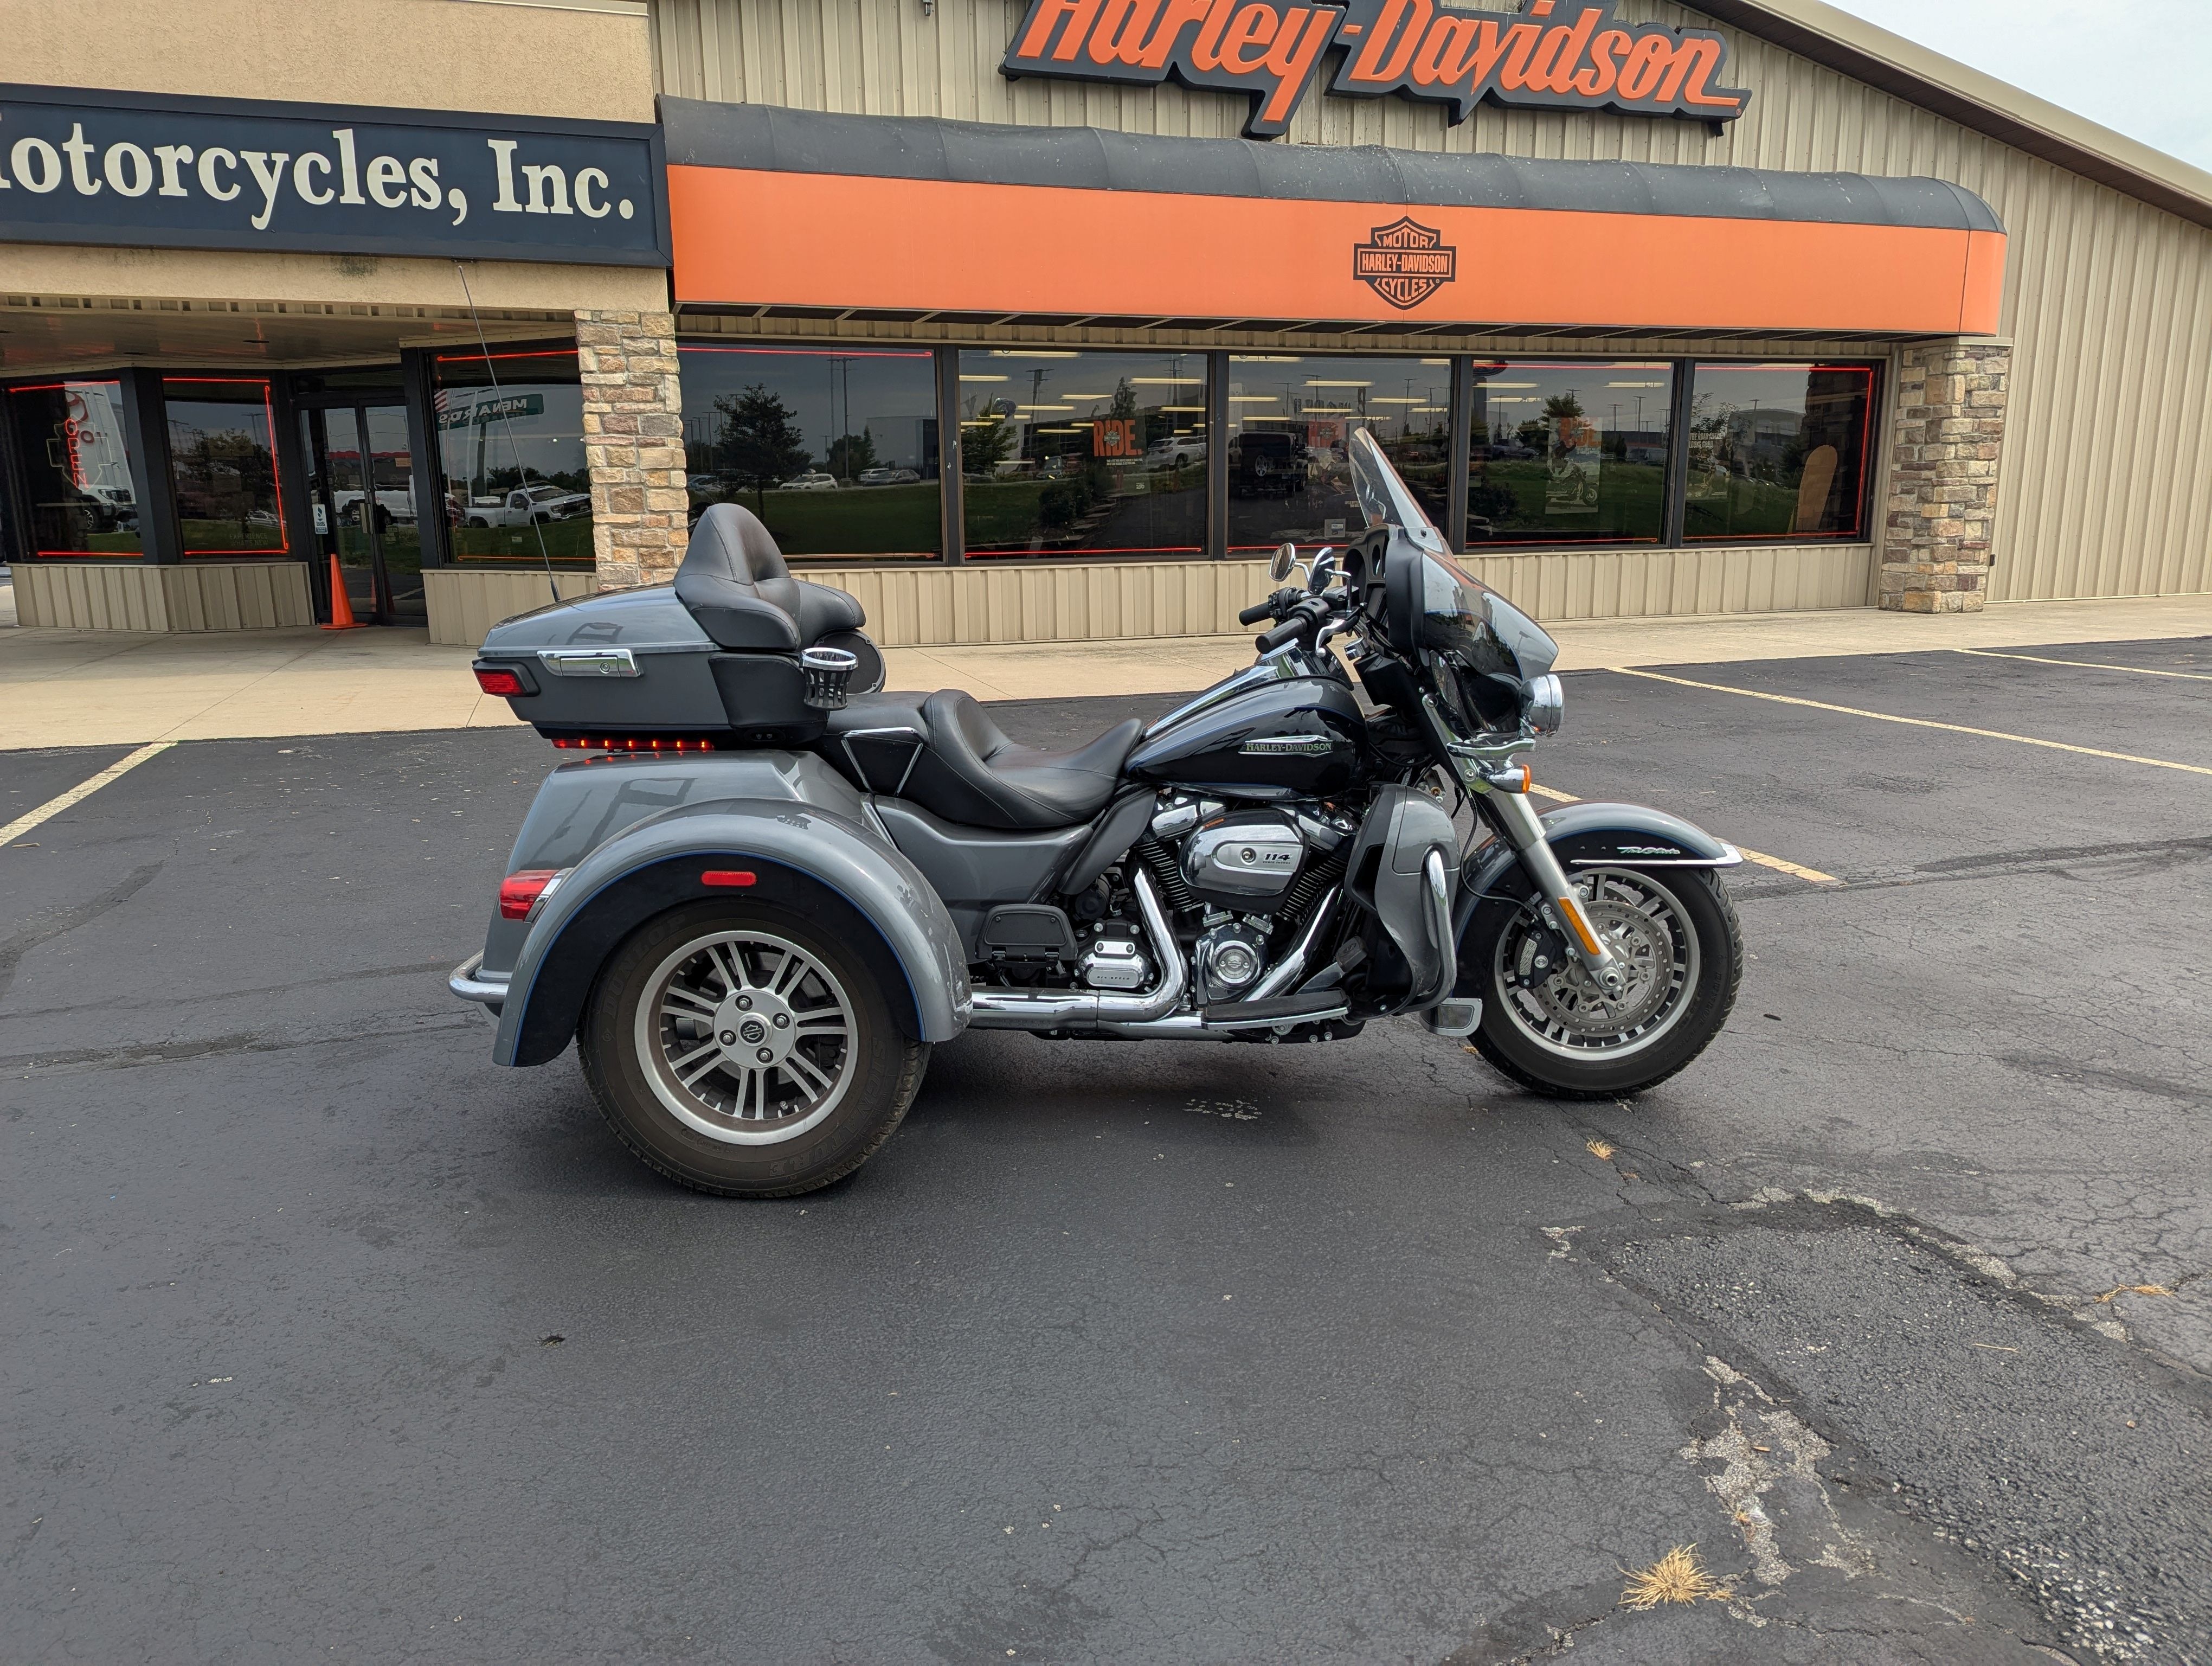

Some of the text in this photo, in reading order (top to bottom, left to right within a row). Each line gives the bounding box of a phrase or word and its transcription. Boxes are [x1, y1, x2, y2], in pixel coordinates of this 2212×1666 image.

[1017, 0, 1741, 123] Harley-Davidson
[0, 113, 634, 229] otorcycles, Inc.
[1383, 227, 1429, 248] MOTOR
[1362, 253, 1448, 273] HARLEY-DAVIDSON
[1381, 278, 1427, 302] CYCLES
[65, 418, 89, 489] OPEN
[1093, 419, 1143, 457] RIDE.
[1246, 742, 1332, 752] HARLEY-DAVIDSON
[1264, 853, 1291, 861] 114
[602, 914, 686, 1020] DUNLOP
[768, 1036, 883, 1177] SIGNATURE
